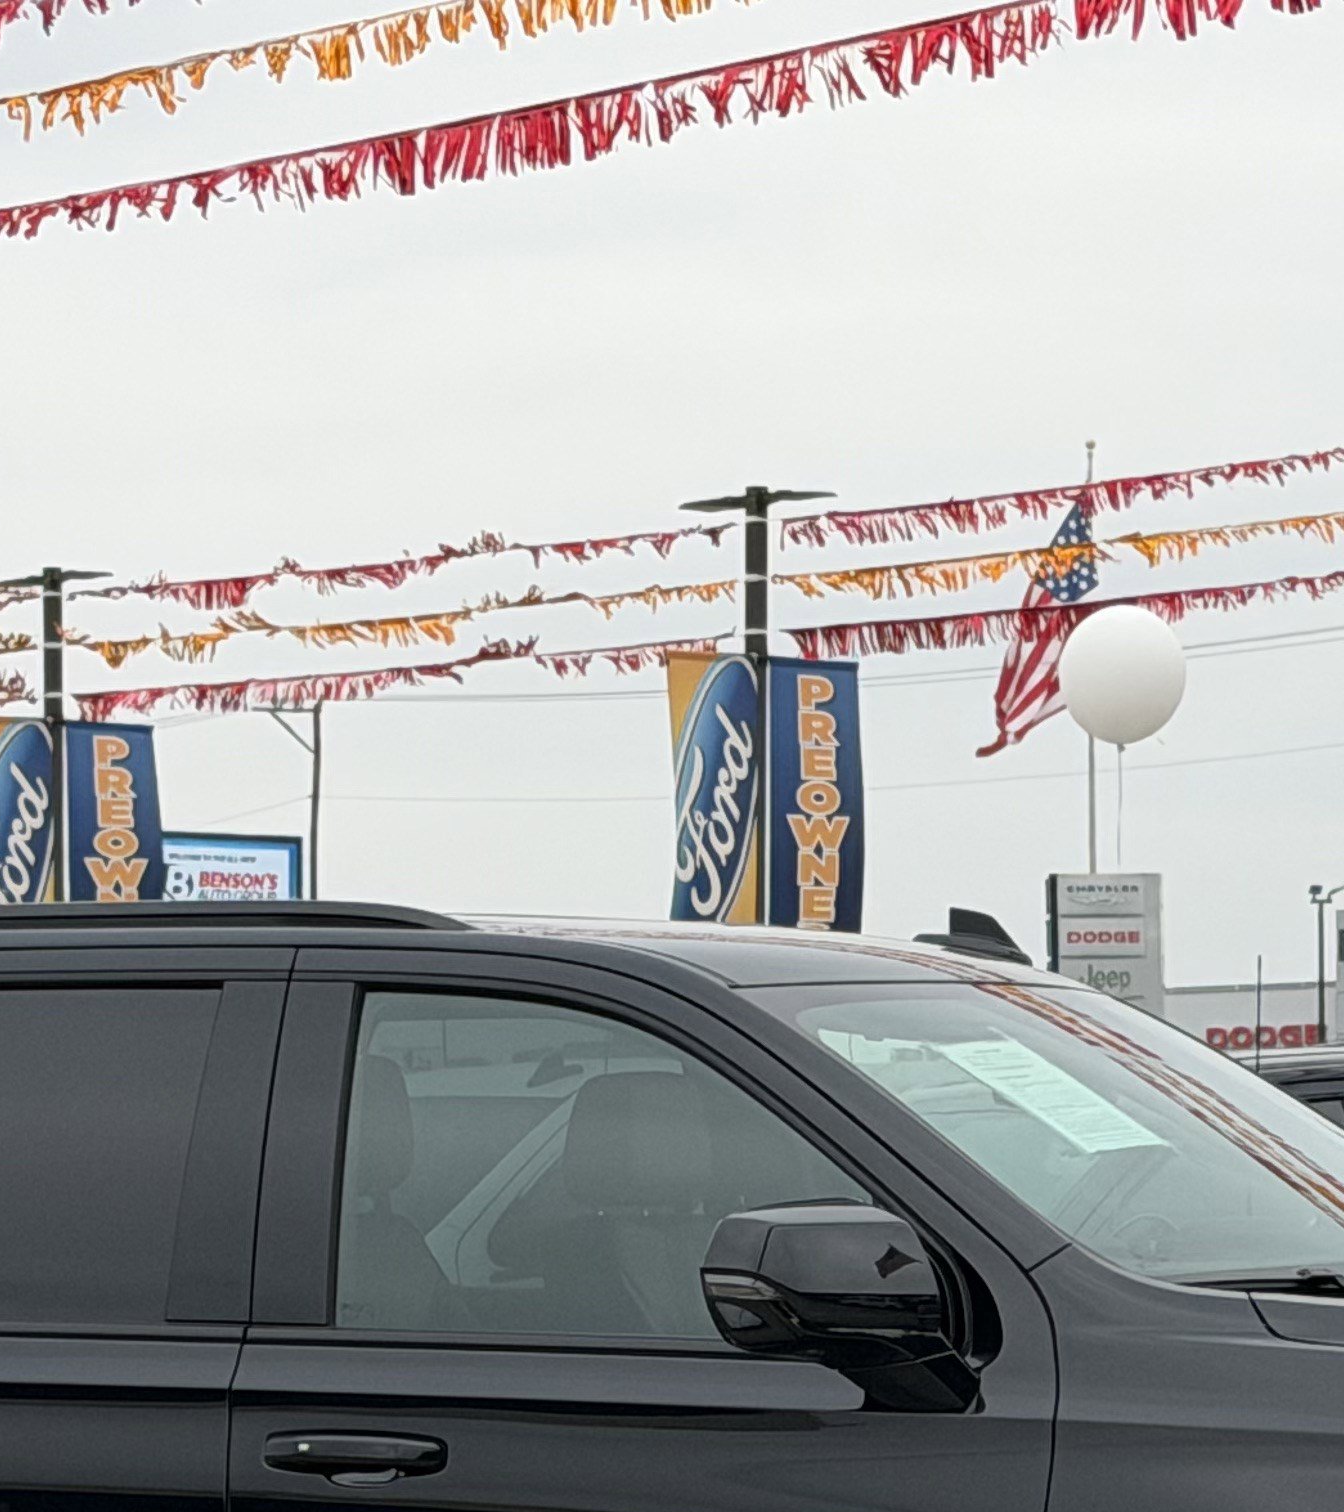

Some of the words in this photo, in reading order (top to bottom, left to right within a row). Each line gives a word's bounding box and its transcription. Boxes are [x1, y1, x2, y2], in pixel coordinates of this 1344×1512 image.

[675, 703, 753, 915] Ford
[786, 674, 850, 929] PREOWNE
[198, 870, 279, 891] BENSON'S
[1066, 931, 1141, 944] DODGE
[1078, 963, 1131, 992] Jeep
[1205, 1023, 1323, 1050] DODGE
